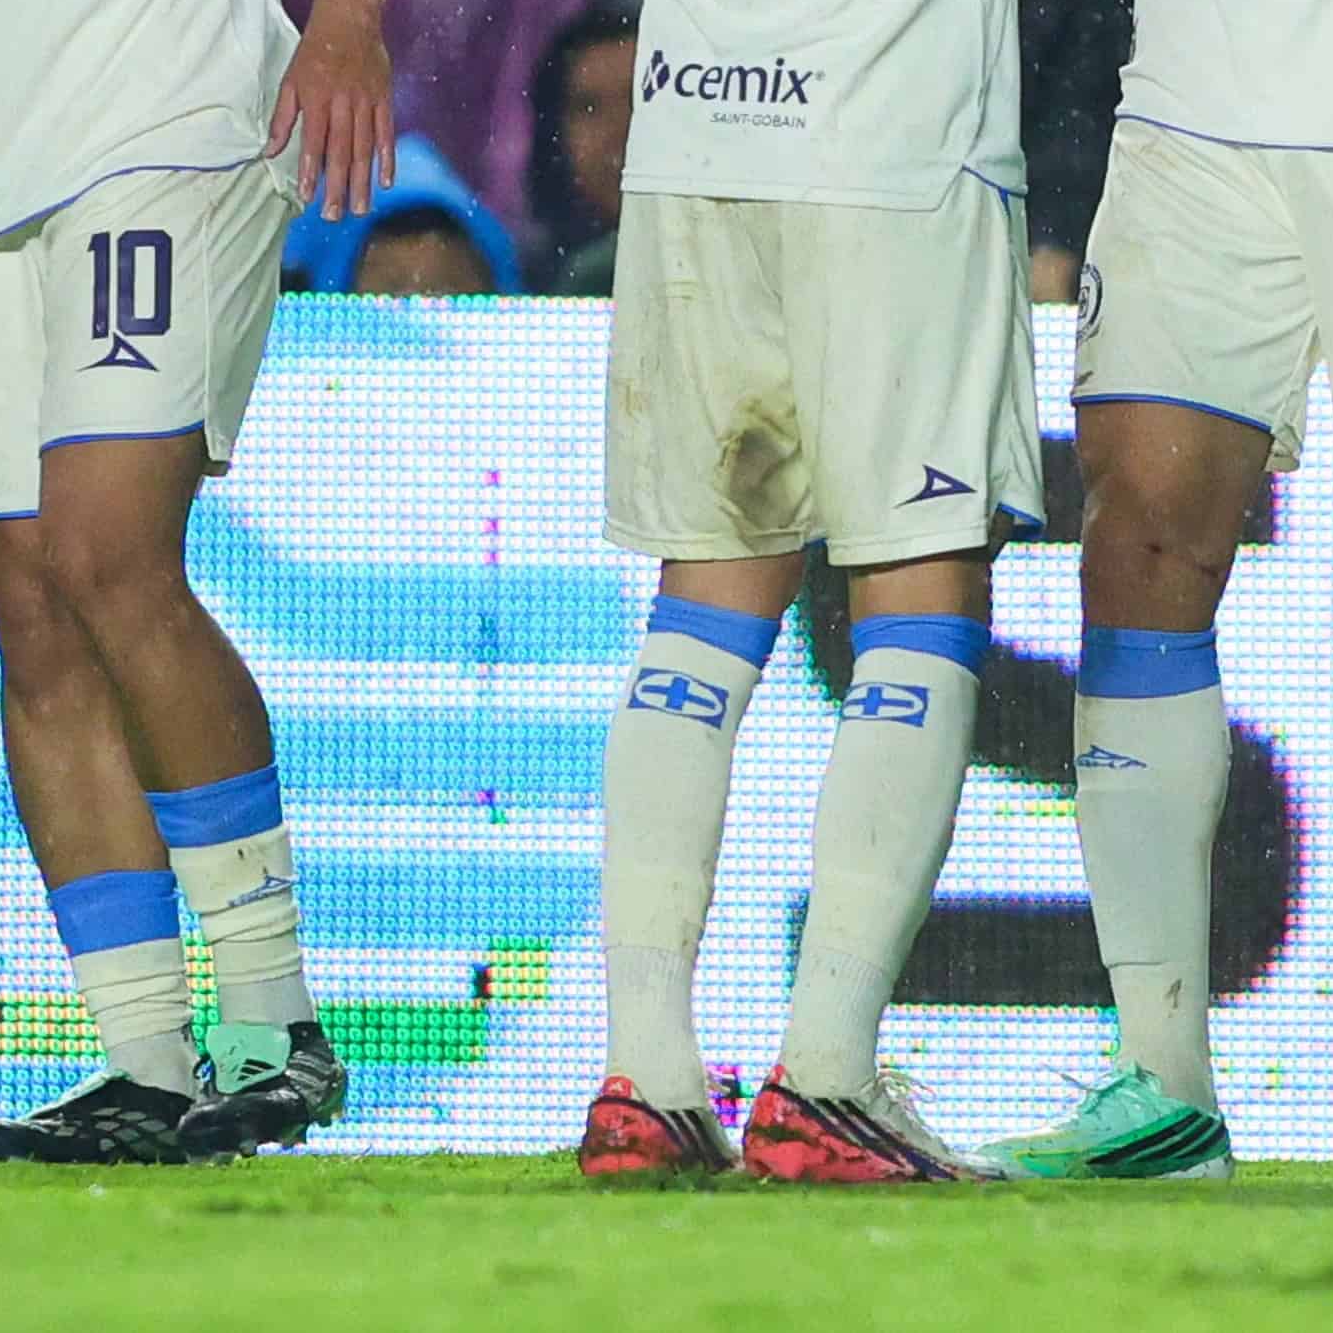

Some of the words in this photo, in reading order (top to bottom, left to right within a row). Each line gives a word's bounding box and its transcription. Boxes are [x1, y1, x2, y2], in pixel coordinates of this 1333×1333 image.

[674, 57, 813, 104] cemix
[711, 112, 806, 129] SAINT-GOBAIN
[87, 229, 173, 339] 10
